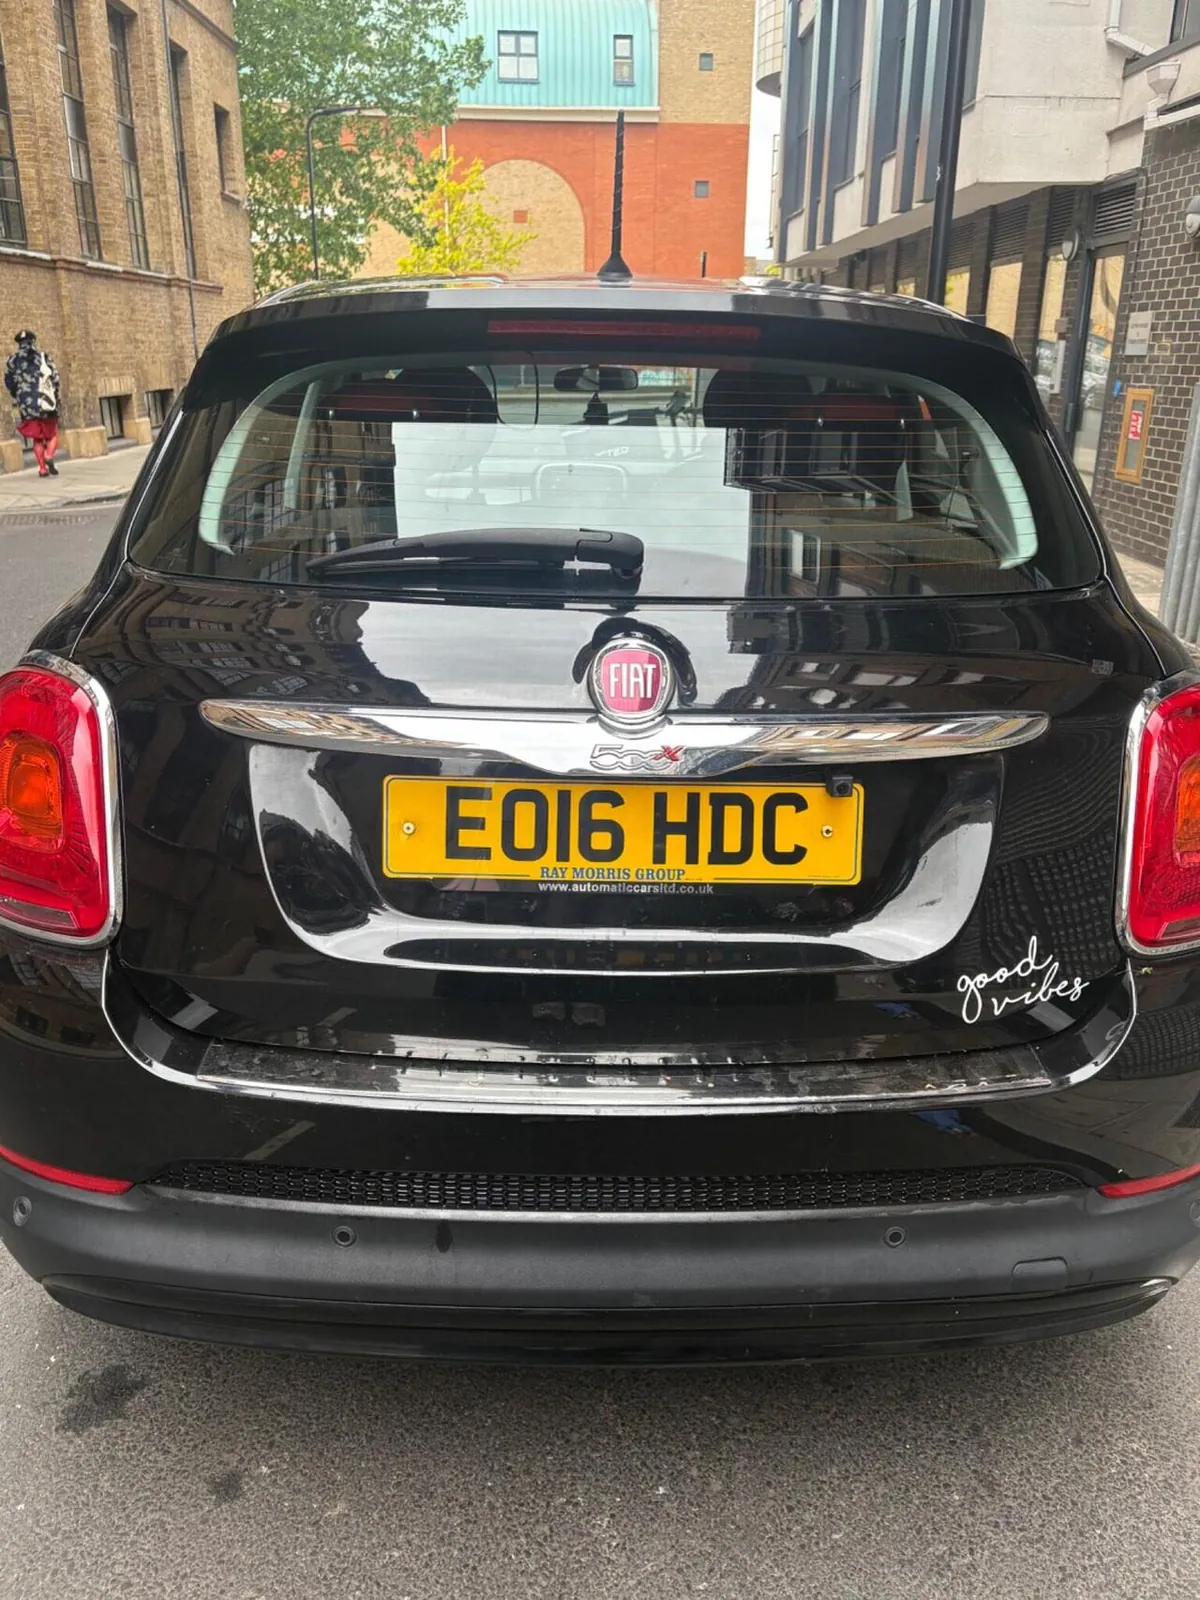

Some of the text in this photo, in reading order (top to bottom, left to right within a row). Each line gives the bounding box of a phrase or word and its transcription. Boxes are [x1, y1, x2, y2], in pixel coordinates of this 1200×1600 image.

[608, 662, 658, 698] FIAT
[445, 785, 809, 866] EO16 HDC
[538, 882, 715, 895] www.automaticcarsltd.co.uk
[540, 866, 686, 881] RAY MORRIS GROUP
[957, 935, 1054, 1024] good
[991, 961, 1091, 1016] vibes
